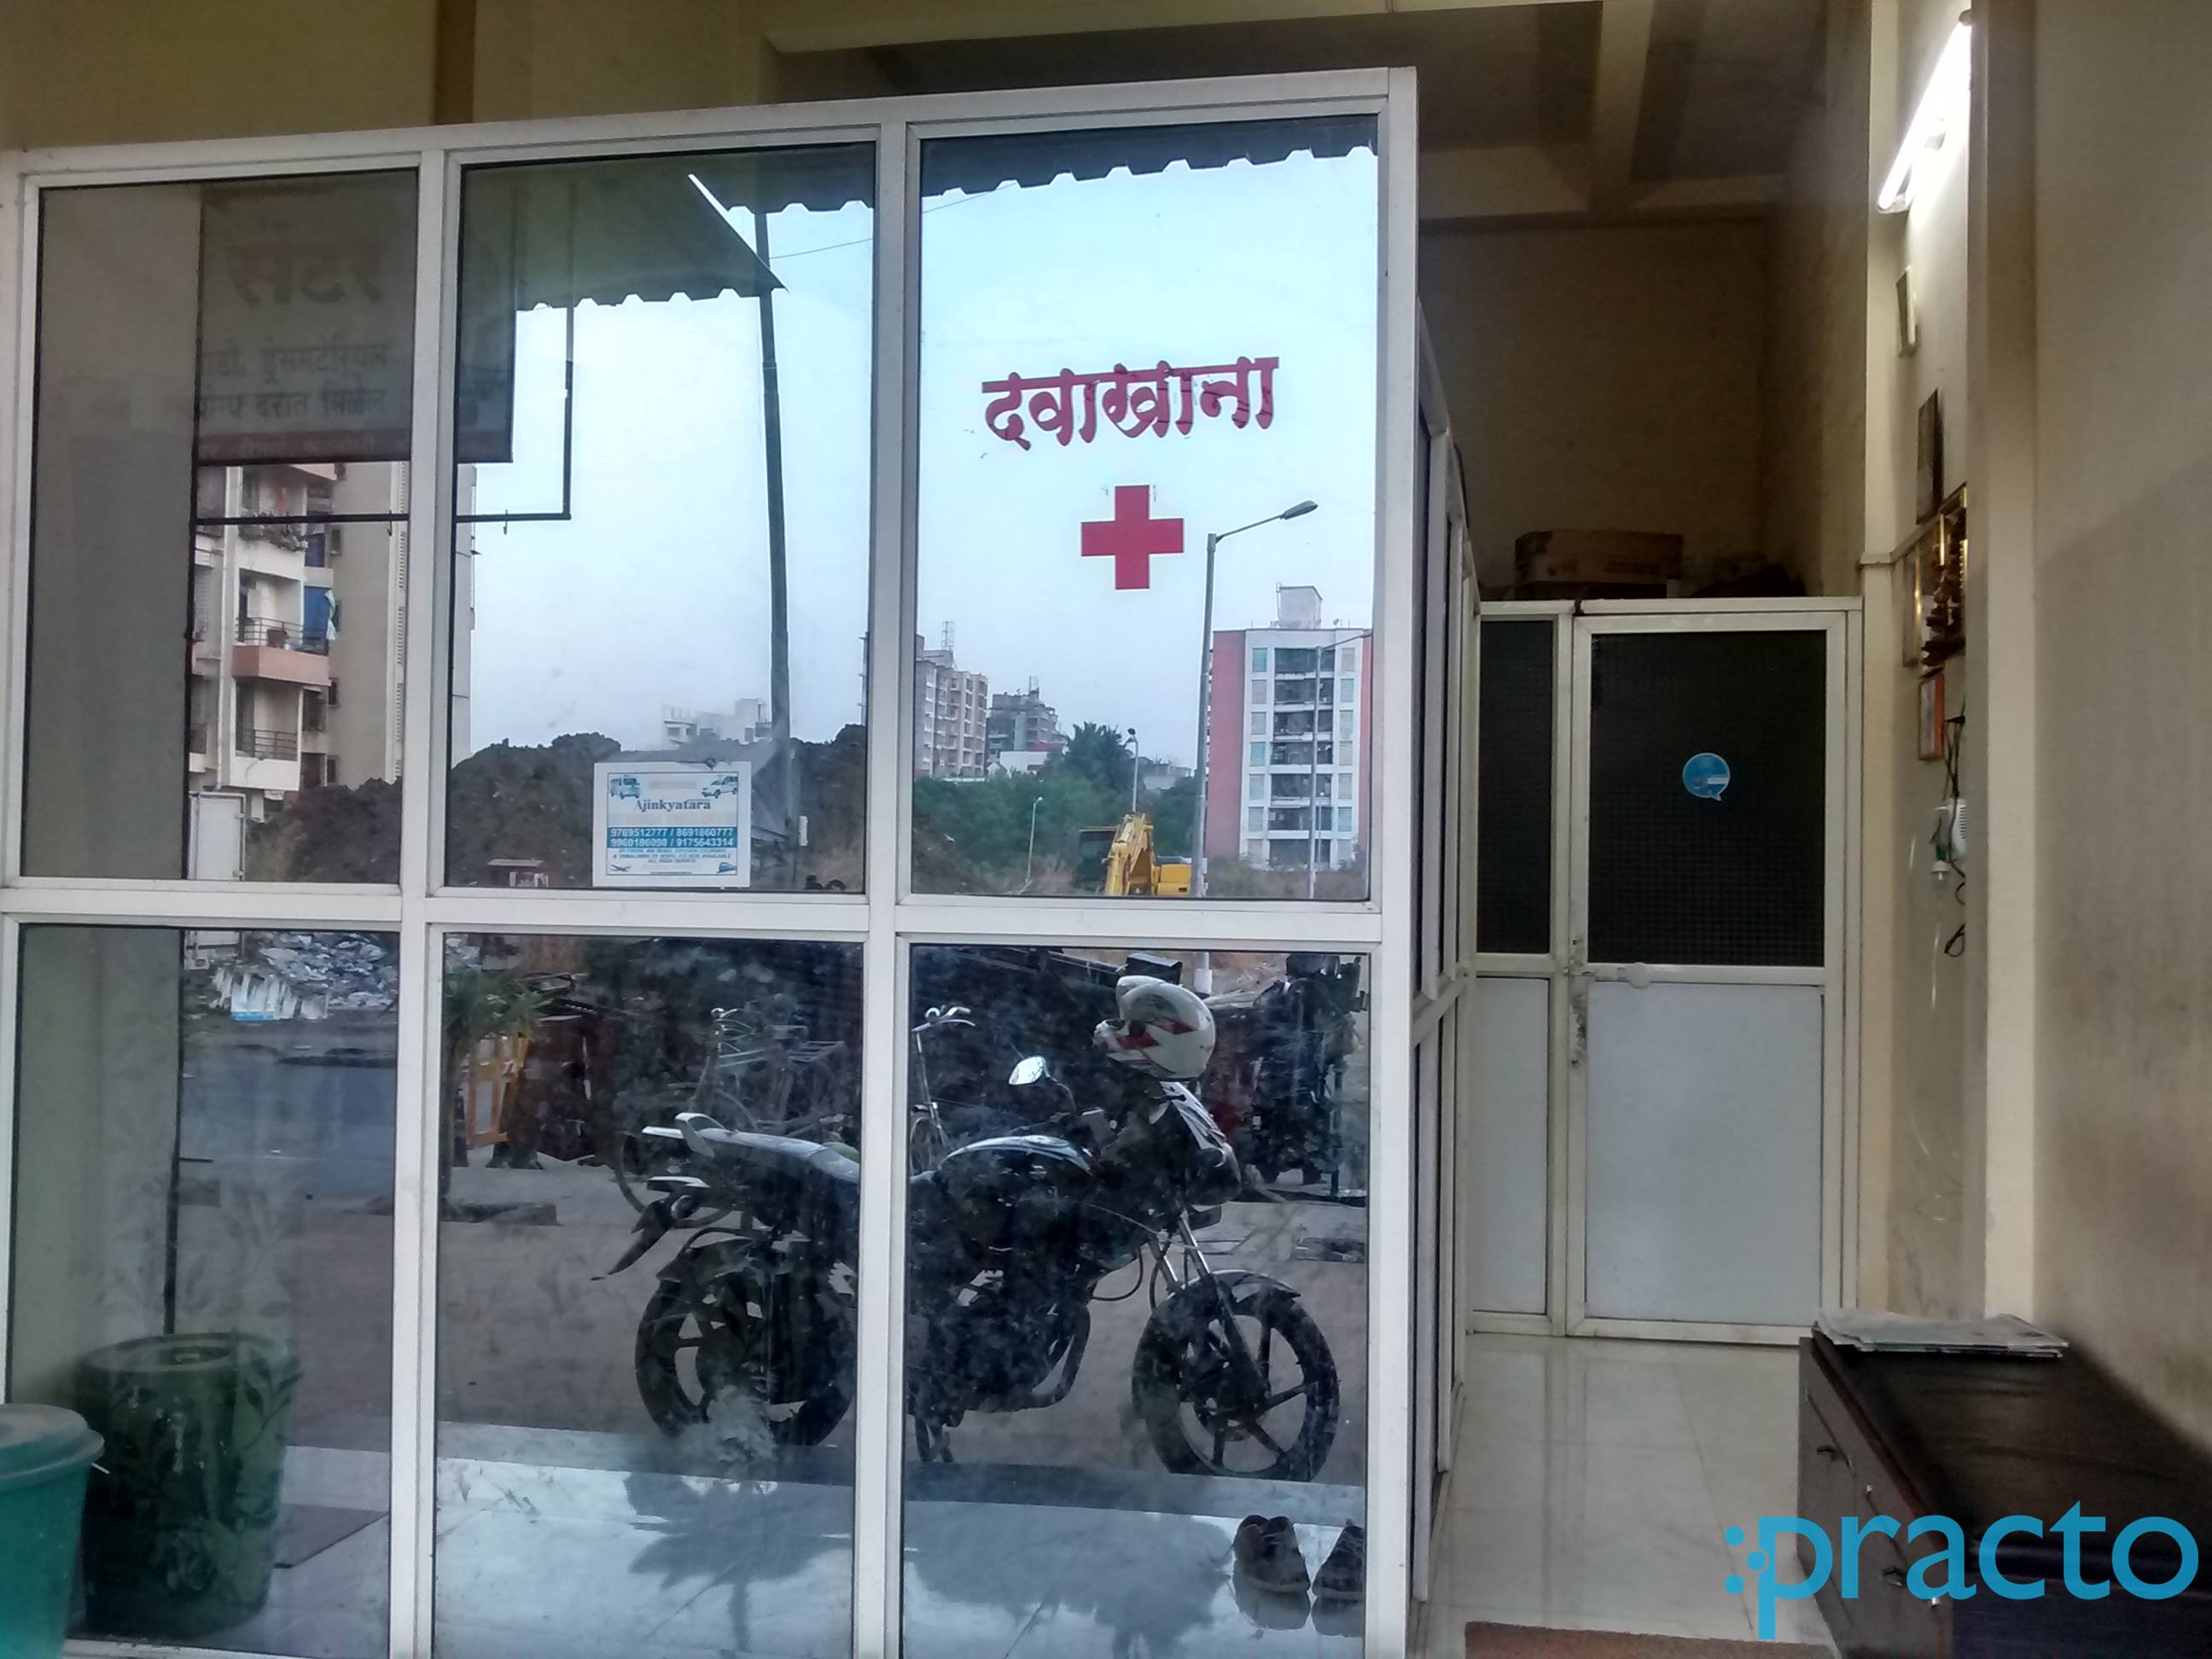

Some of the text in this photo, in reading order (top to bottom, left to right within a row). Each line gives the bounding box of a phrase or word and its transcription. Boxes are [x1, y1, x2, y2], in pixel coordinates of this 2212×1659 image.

[981, 356, 1279, 451] दवाखाना
[610, 828, 668, 836] 9769512777
[676, 828, 733, 836] 8691860777
